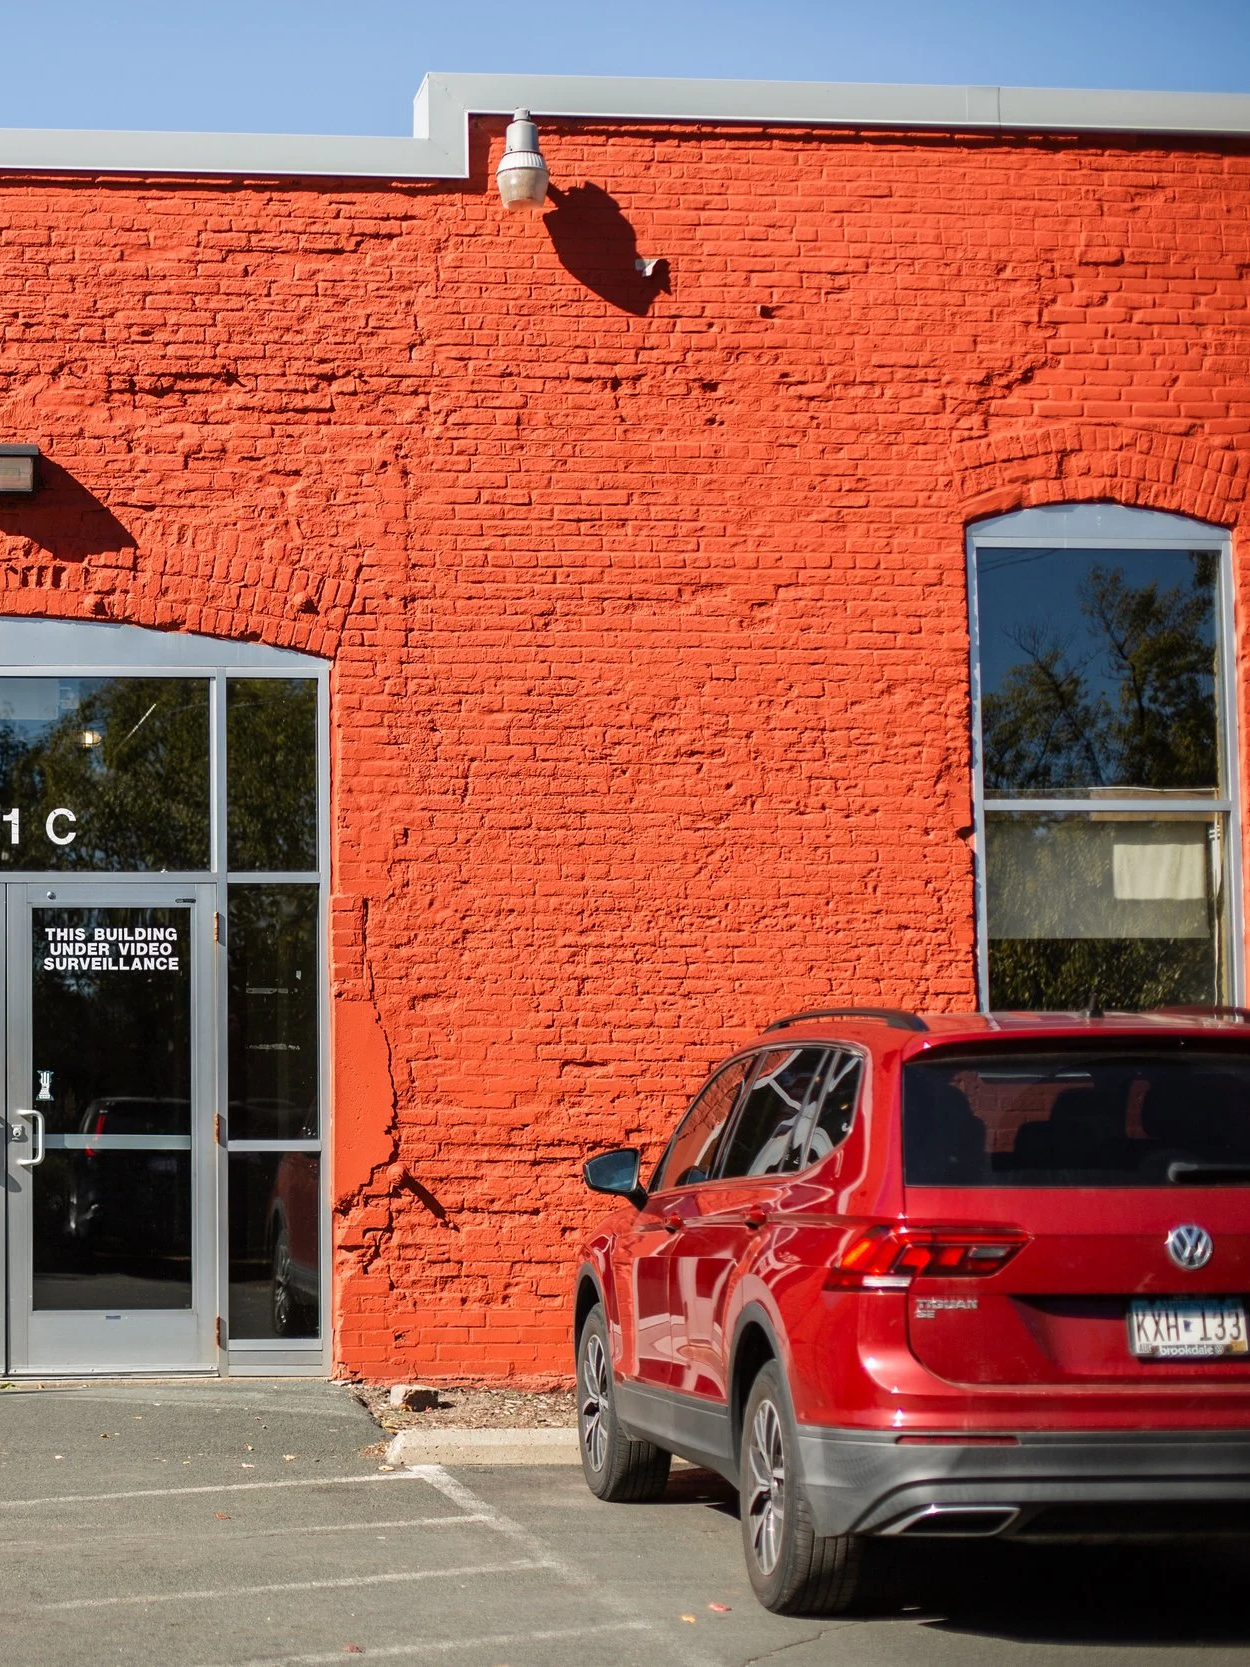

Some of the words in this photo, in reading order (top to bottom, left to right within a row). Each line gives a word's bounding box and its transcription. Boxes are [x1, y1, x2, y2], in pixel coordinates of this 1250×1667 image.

[45, 807, 77, 846] C
[44, 927, 85, 941] THIS
[94, 927, 178, 941] BUILDING
[49, 942, 110, 956] UNDER
[119, 942, 173, 956] VIDEO
[43, 957, 179, 971] SURVEILLANCE
[916, 1298, 978, 1310] TIGUAN
[916, 1309, 936, 1319] SE
[1134, 1310, 1181, 1342] KXH
[1199, 1309, 1242, 1341] 133
[1159, 1344, 1213, 1355] brookdale
